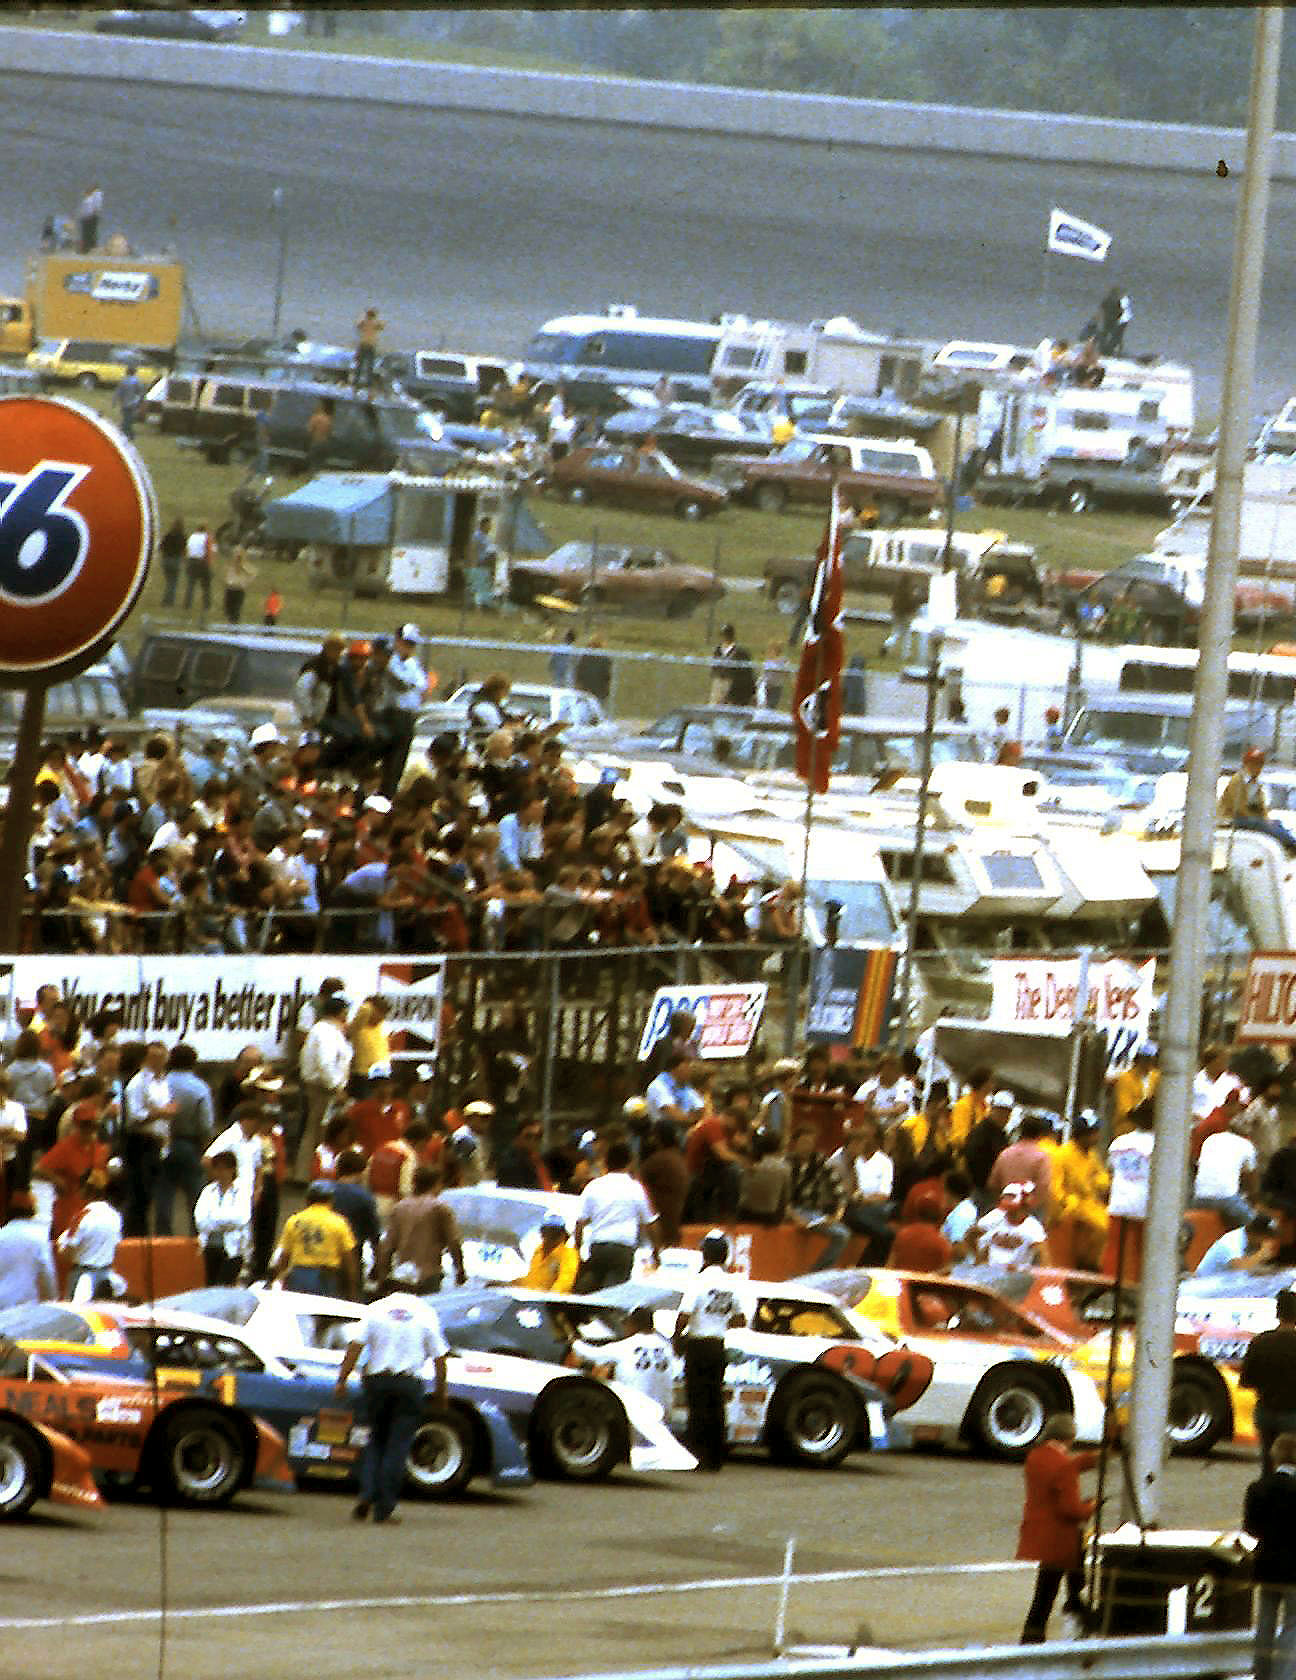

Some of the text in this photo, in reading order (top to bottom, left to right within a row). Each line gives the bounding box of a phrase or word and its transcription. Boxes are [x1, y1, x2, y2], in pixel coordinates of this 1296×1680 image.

[0, 460, 92, 606] 6
[153, 977, 195, 1041] buy
[195, 993, 209, 1031] a
[212, 977, 276, 1031] better
